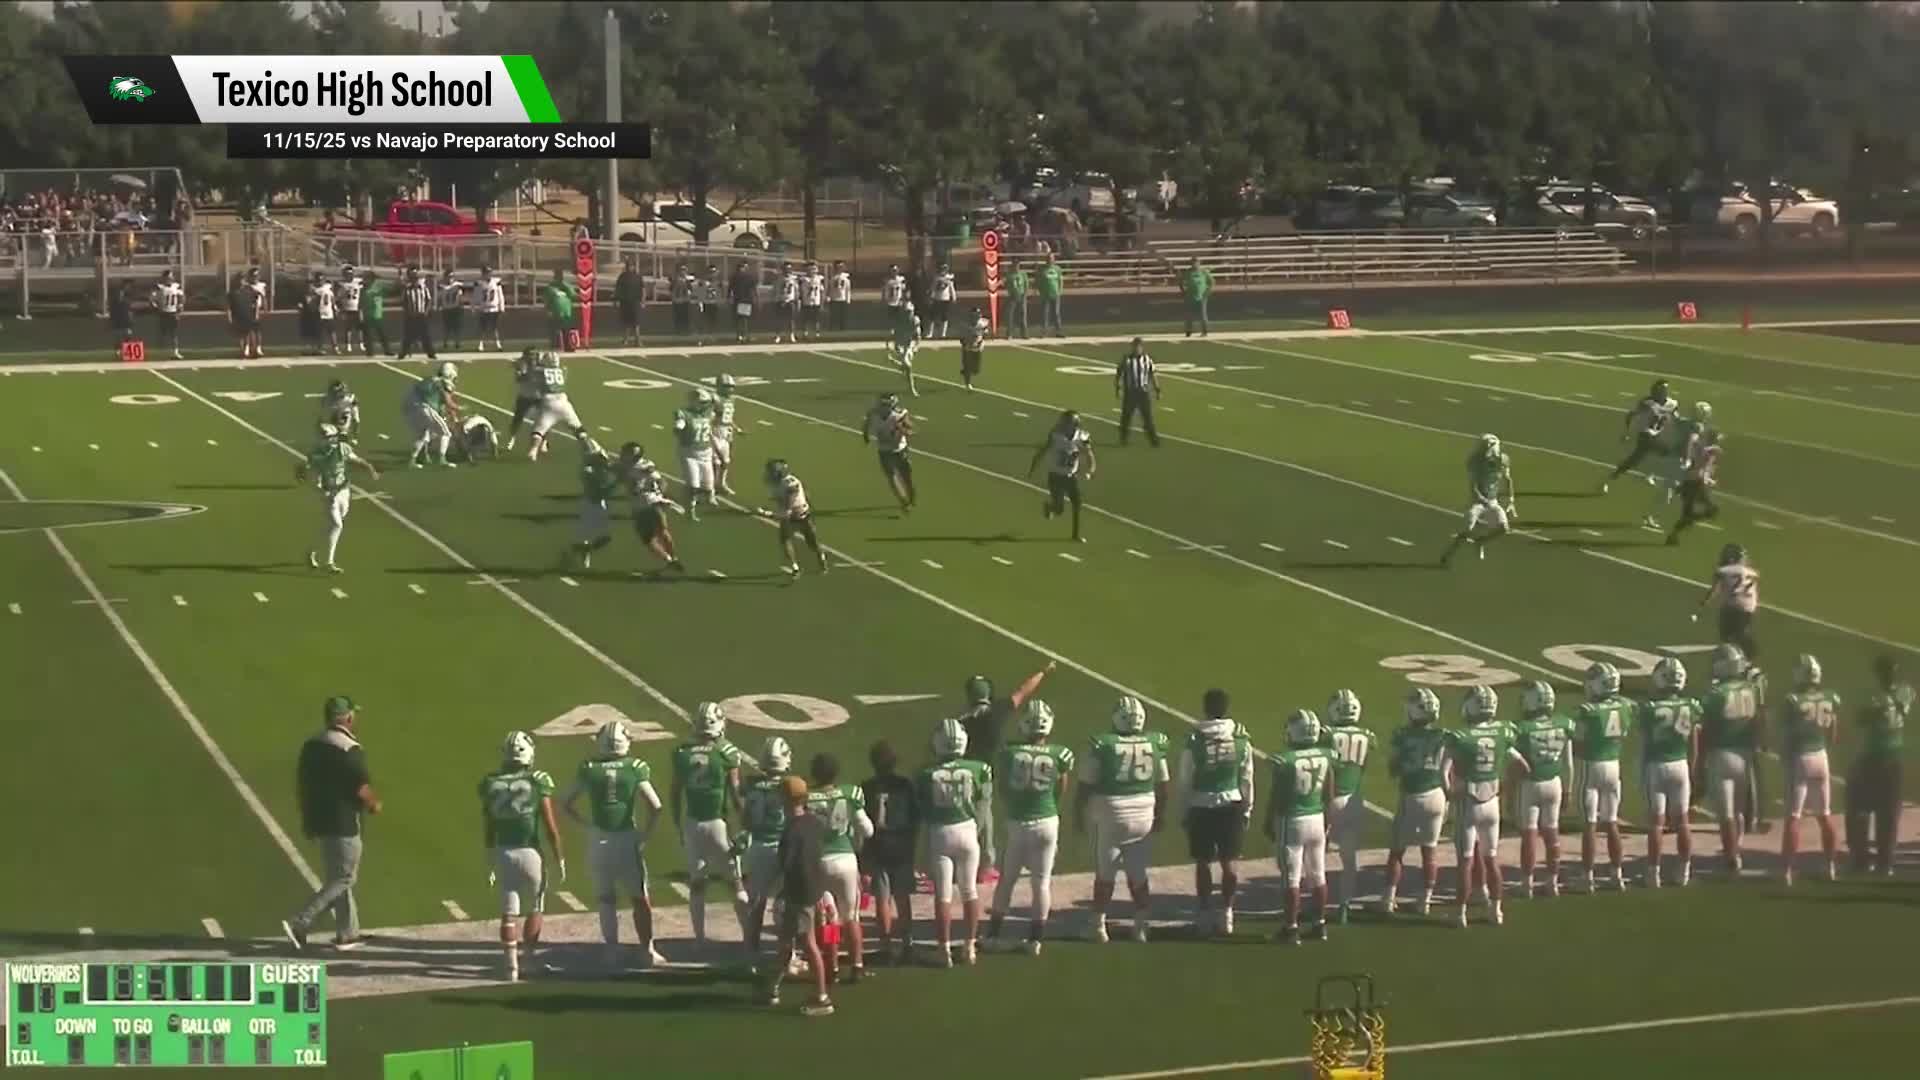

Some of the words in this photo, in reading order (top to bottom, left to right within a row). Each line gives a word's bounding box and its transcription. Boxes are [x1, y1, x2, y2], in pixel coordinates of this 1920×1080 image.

[126, 343, 143, 361] 40
[543, 367, 565, 386] 56
[1115, 742, 1156, 782] 75
[1295, 756, 1329, 796] 67
